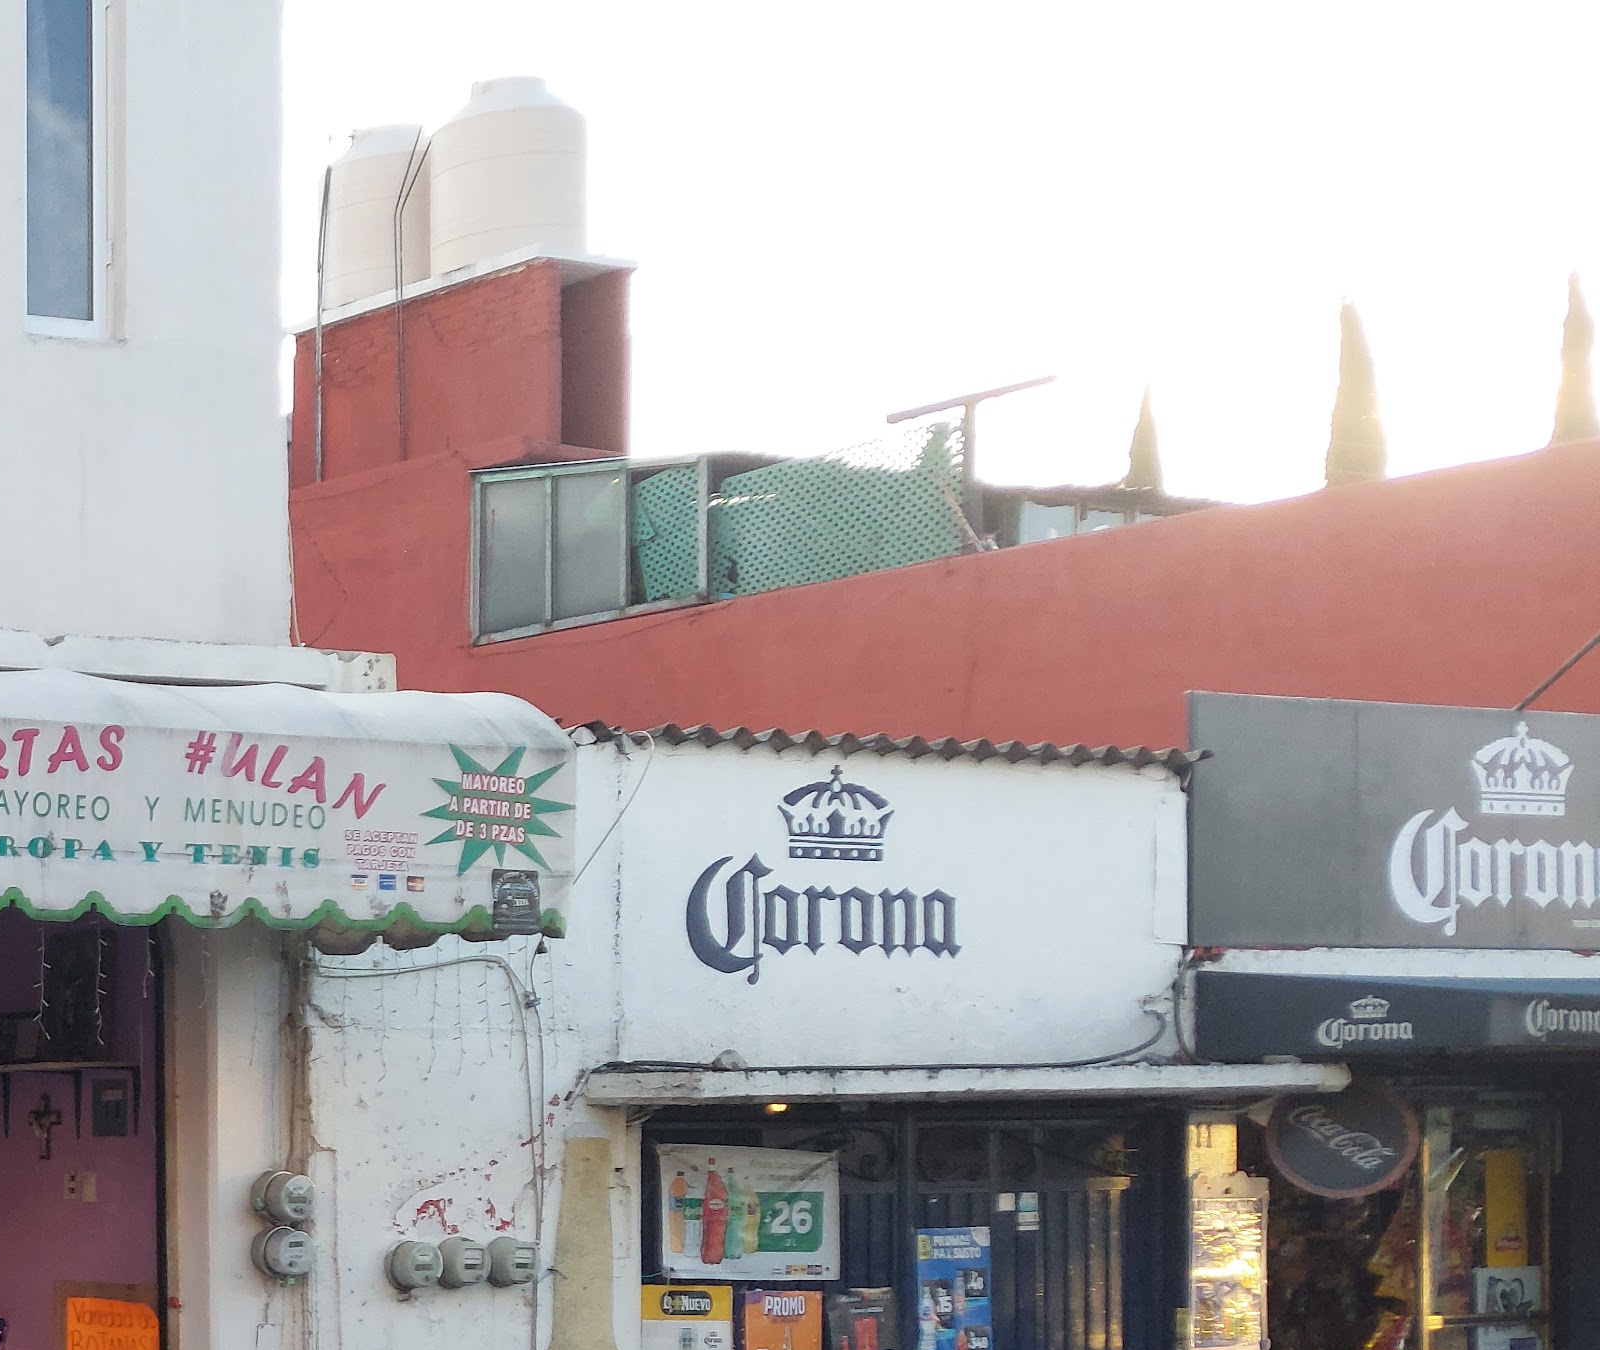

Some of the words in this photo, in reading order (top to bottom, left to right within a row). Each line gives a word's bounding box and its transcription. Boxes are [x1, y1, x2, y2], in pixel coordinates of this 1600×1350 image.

[462, 773, 525, 795] MAYOREO
[145, 796, 157, 822] Y
[184, 797, 326, 831] MENUDEO
[449, 795, 459, 812] A
[463, 797, 510, 817] PARTIR
[514, 802, 531, 819] DE
[345, 830, 360, 841] SE
[363, 831, 418, 844] ACEPTAN
[456, 819, 474, 838] DE
[479, 822, 487, 839] 3
[492, 823, 525, 843] PZAS
[139, 842, 163, 863] Y
[186, 844, 321, 868] TENIS
[347, 844, 386, 857] PAGOS
[391, 846, 415, 858] CON
[356, 859, 408, 871] TARJETA
[1390, 806, 1600, 937] Coron
[686, 852, 963, 985] Corona
[1316, 1017, 1414, 1049] Corona
[764, 1296, 805, 1316] PROMO
